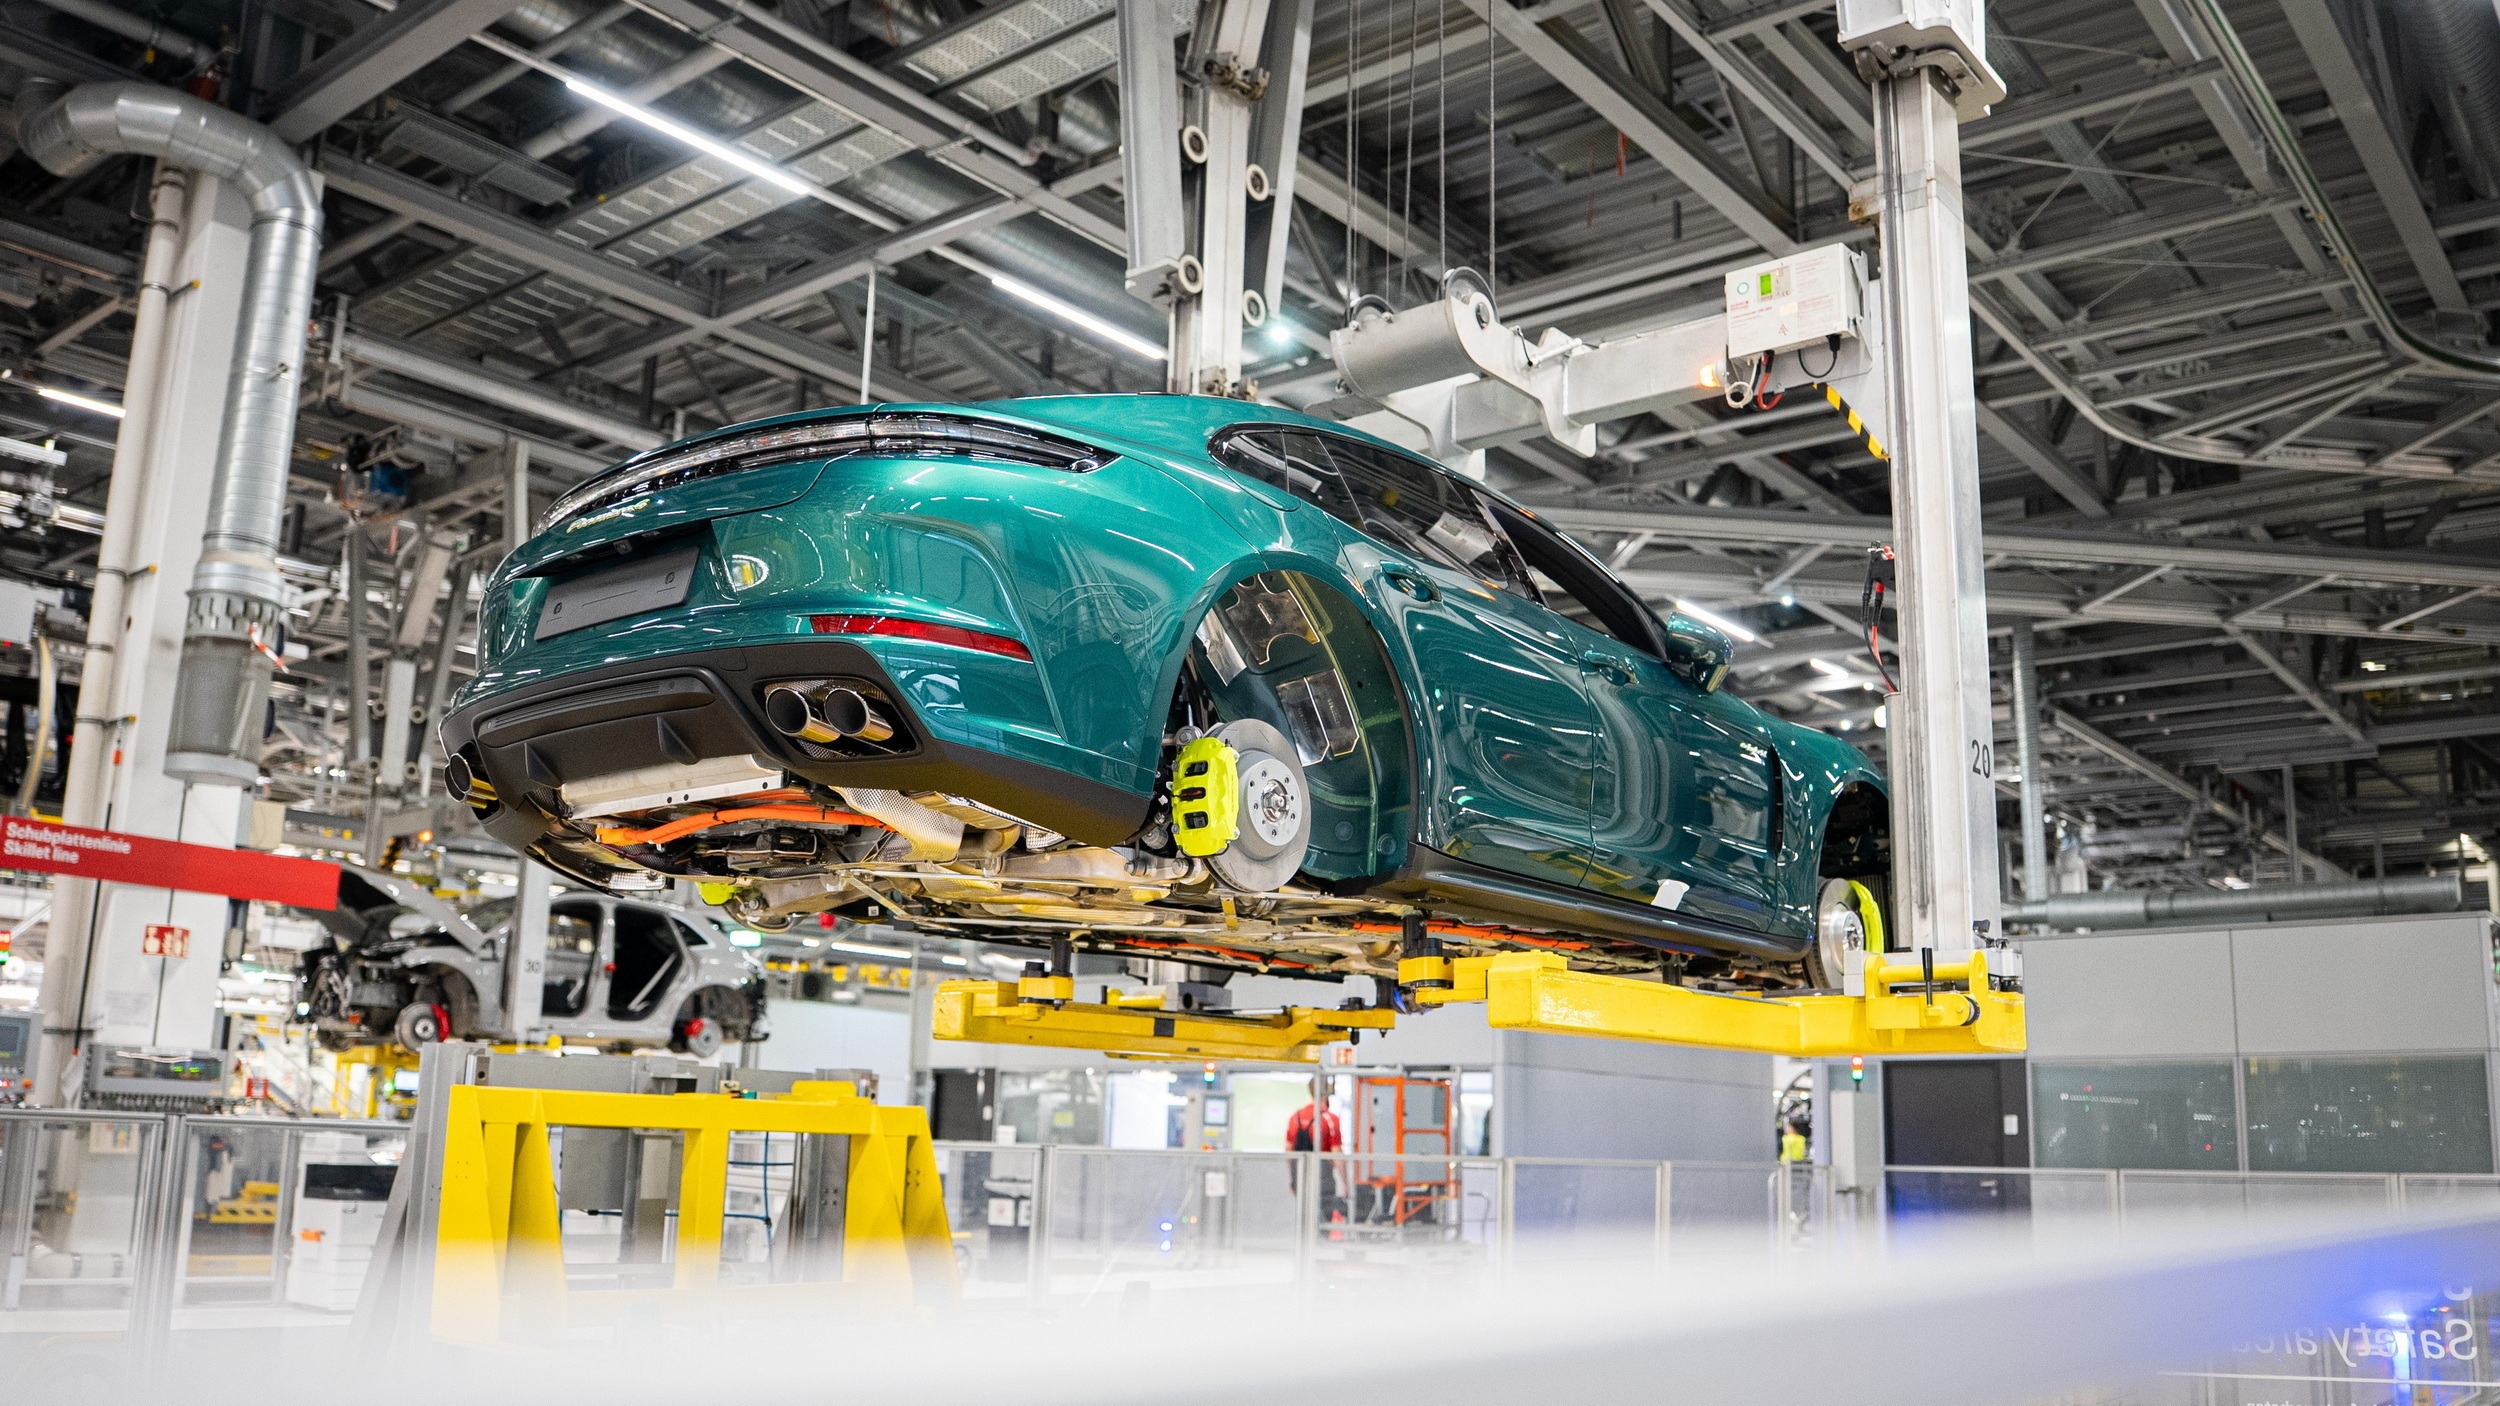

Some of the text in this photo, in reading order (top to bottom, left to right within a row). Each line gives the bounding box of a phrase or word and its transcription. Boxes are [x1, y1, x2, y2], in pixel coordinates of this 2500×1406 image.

[1971, 739, 1991, 779] 20
[4, 839, 80, 864] Skillet line
[6, 822, 132, 855] Schubplattenlinie
